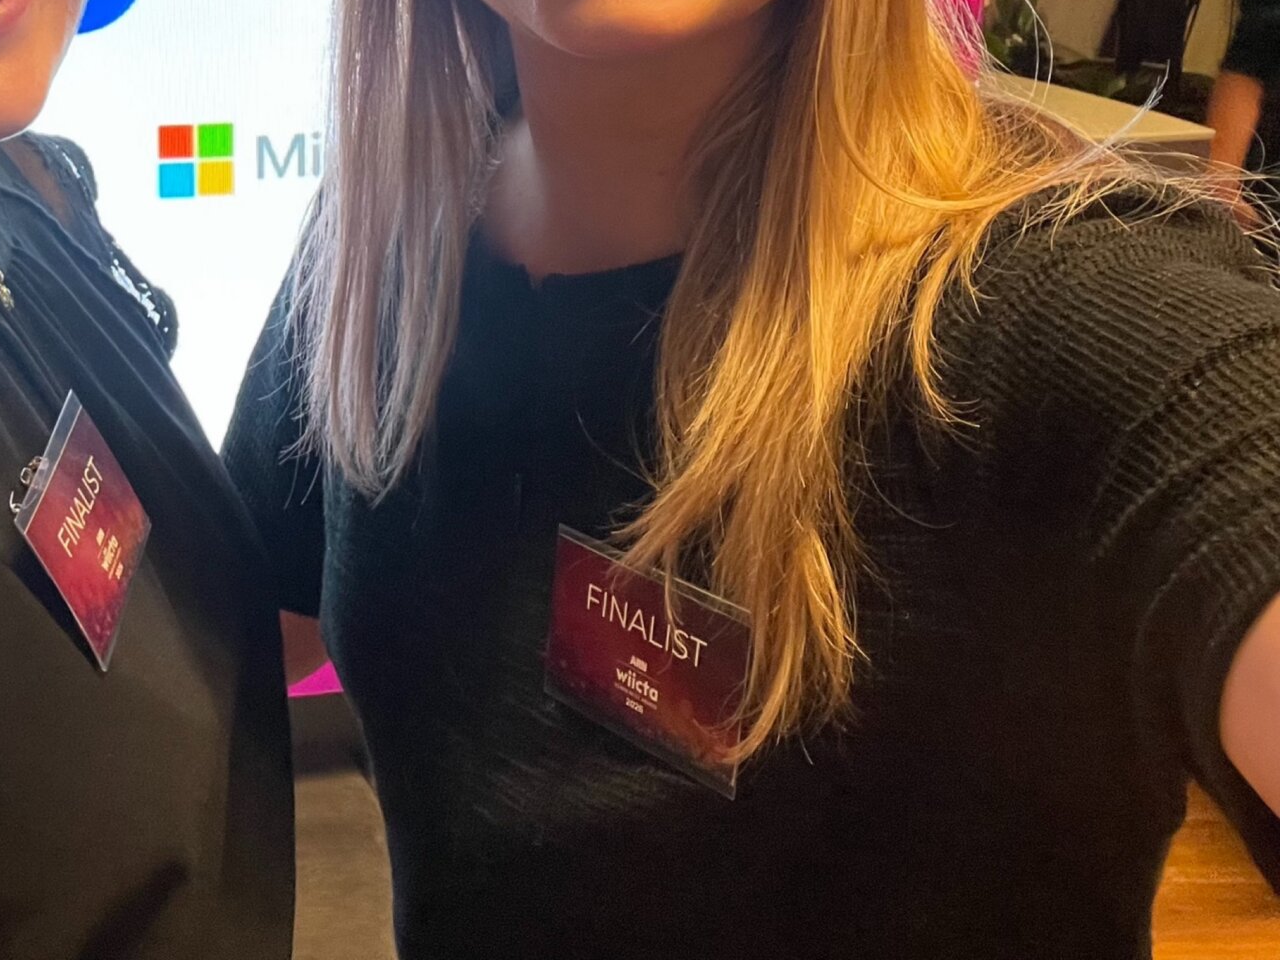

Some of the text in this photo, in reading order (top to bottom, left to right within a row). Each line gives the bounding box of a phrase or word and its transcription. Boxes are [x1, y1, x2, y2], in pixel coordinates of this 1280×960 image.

[57, 455, 104, 558] FINALIST
[586, 583, 708, 668] FINALIST
[616, 667, 659, 702] wiicta
